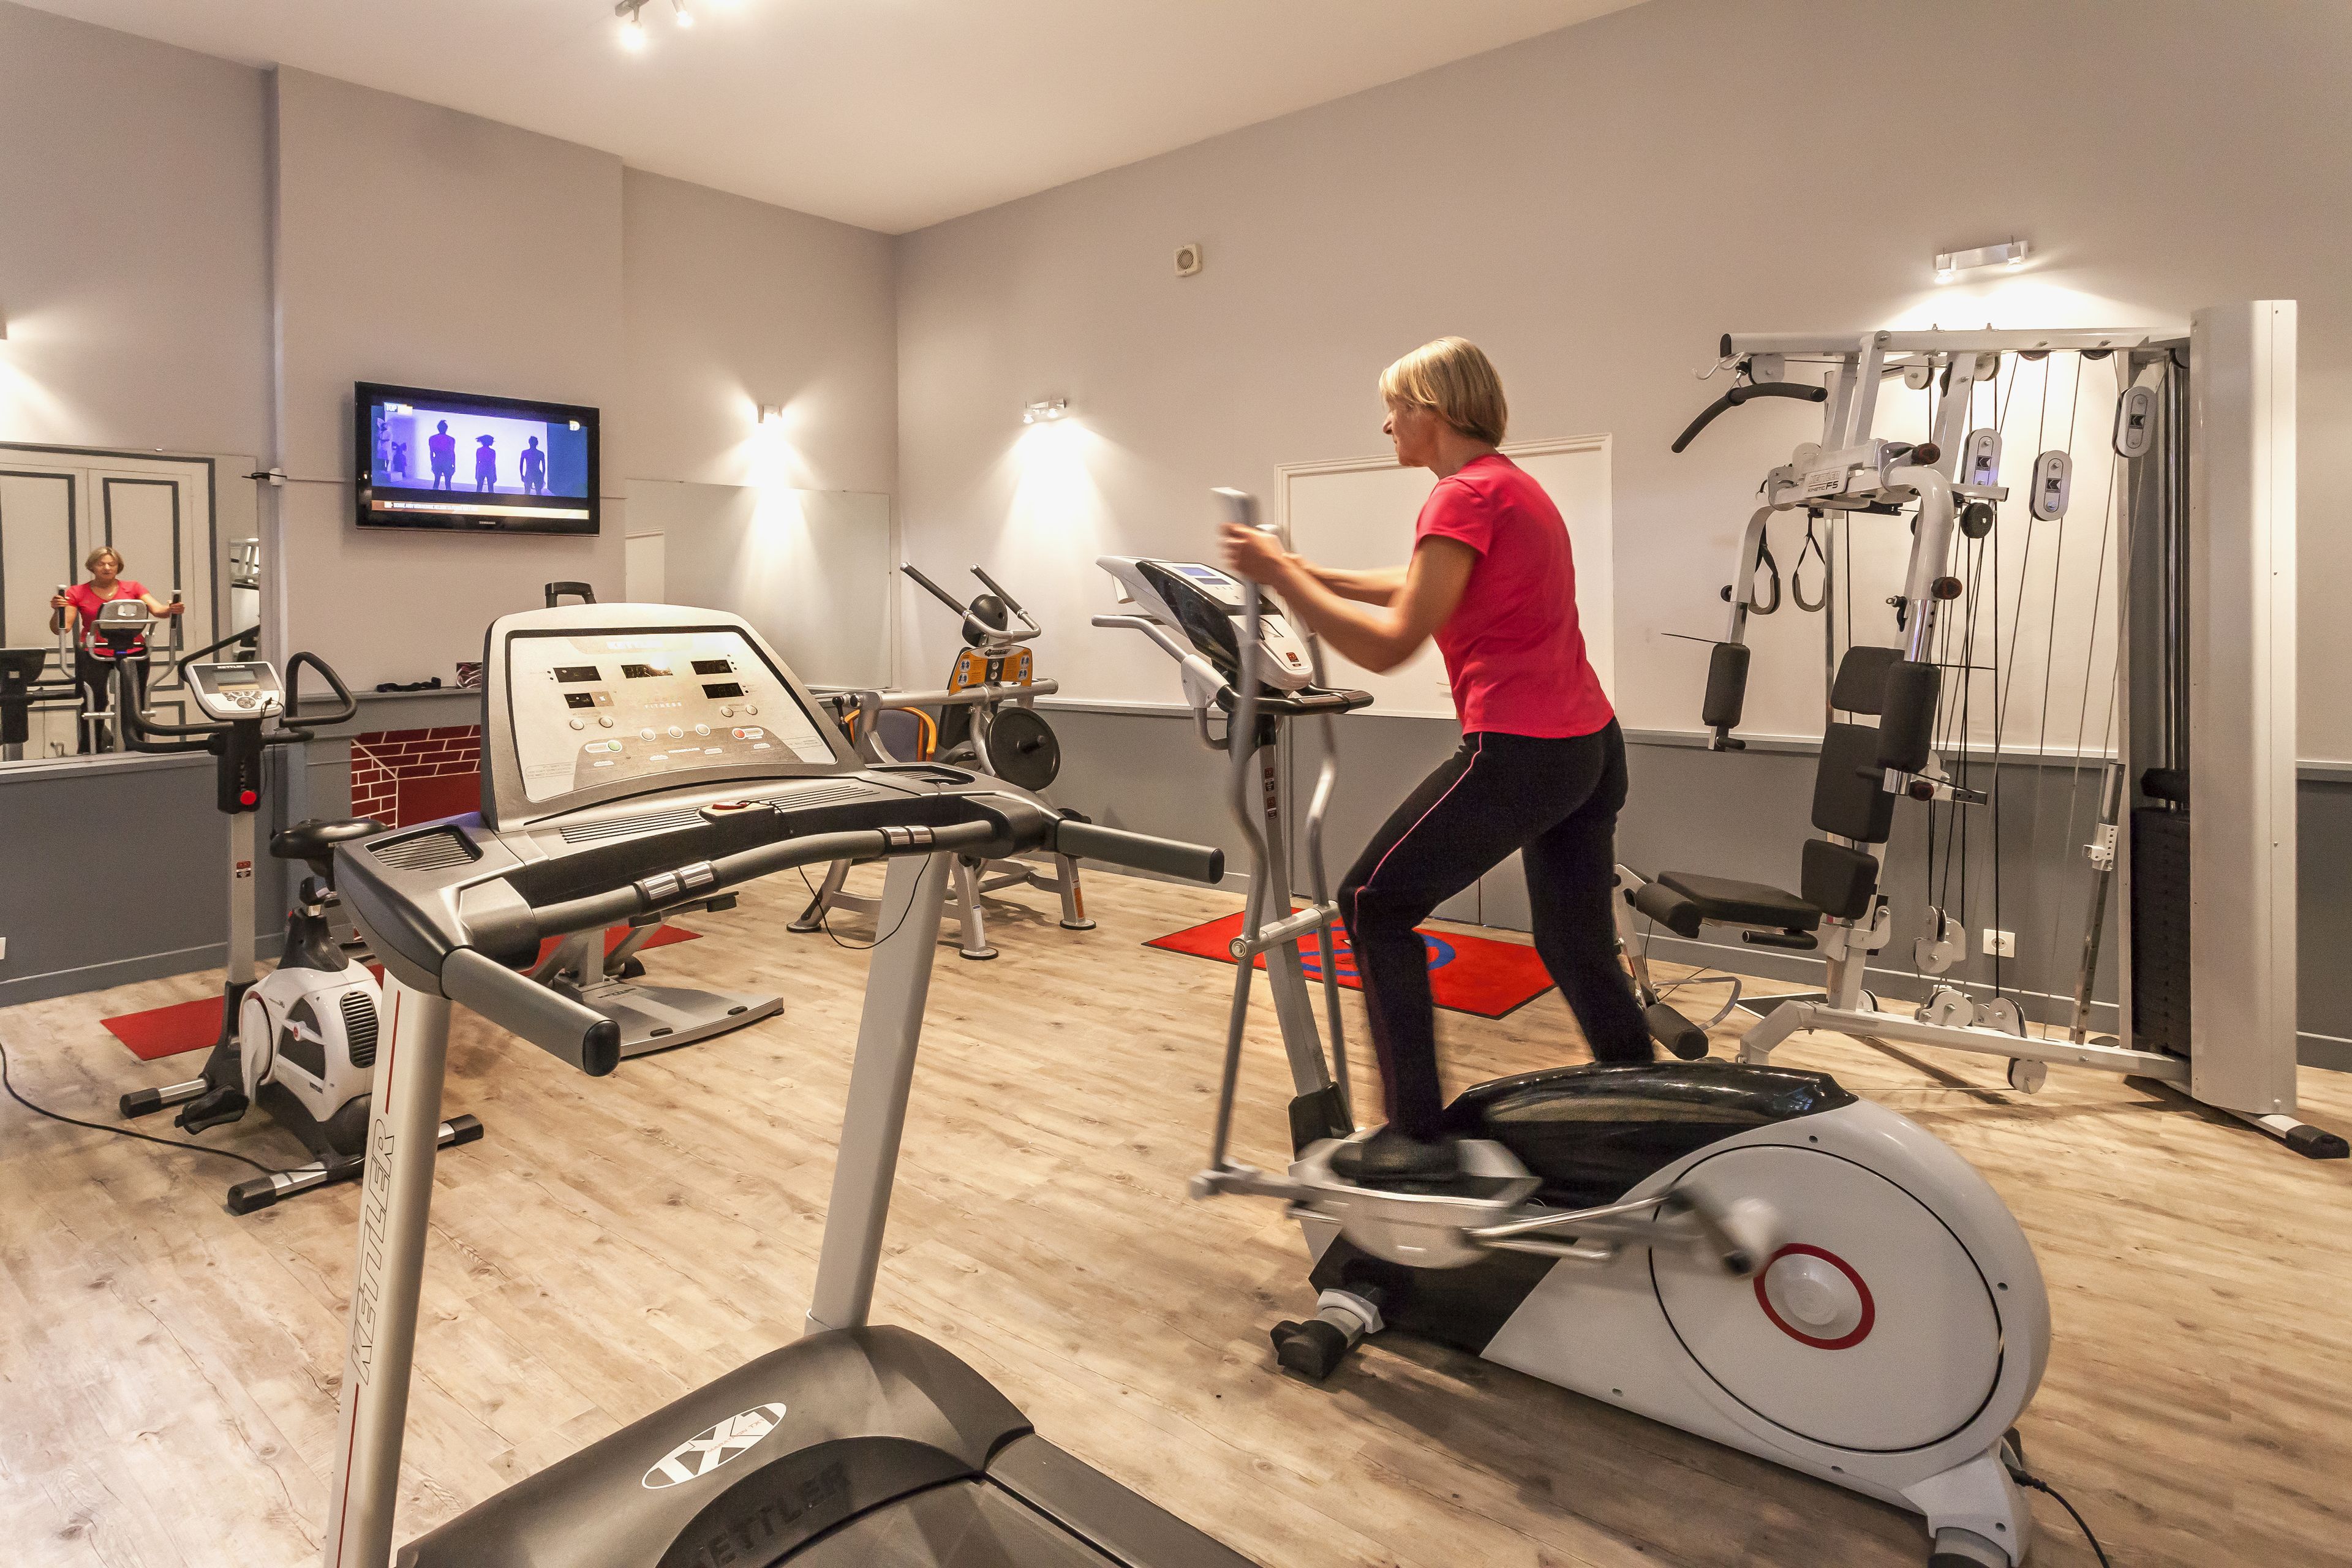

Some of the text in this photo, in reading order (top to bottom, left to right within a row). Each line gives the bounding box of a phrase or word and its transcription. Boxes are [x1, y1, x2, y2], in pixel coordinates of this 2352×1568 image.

[1825, 481, 1839, 490] F5
[351, 1118, 395, 1385] KETTLER
[696, 1461, 851, 1568] ETTLER
